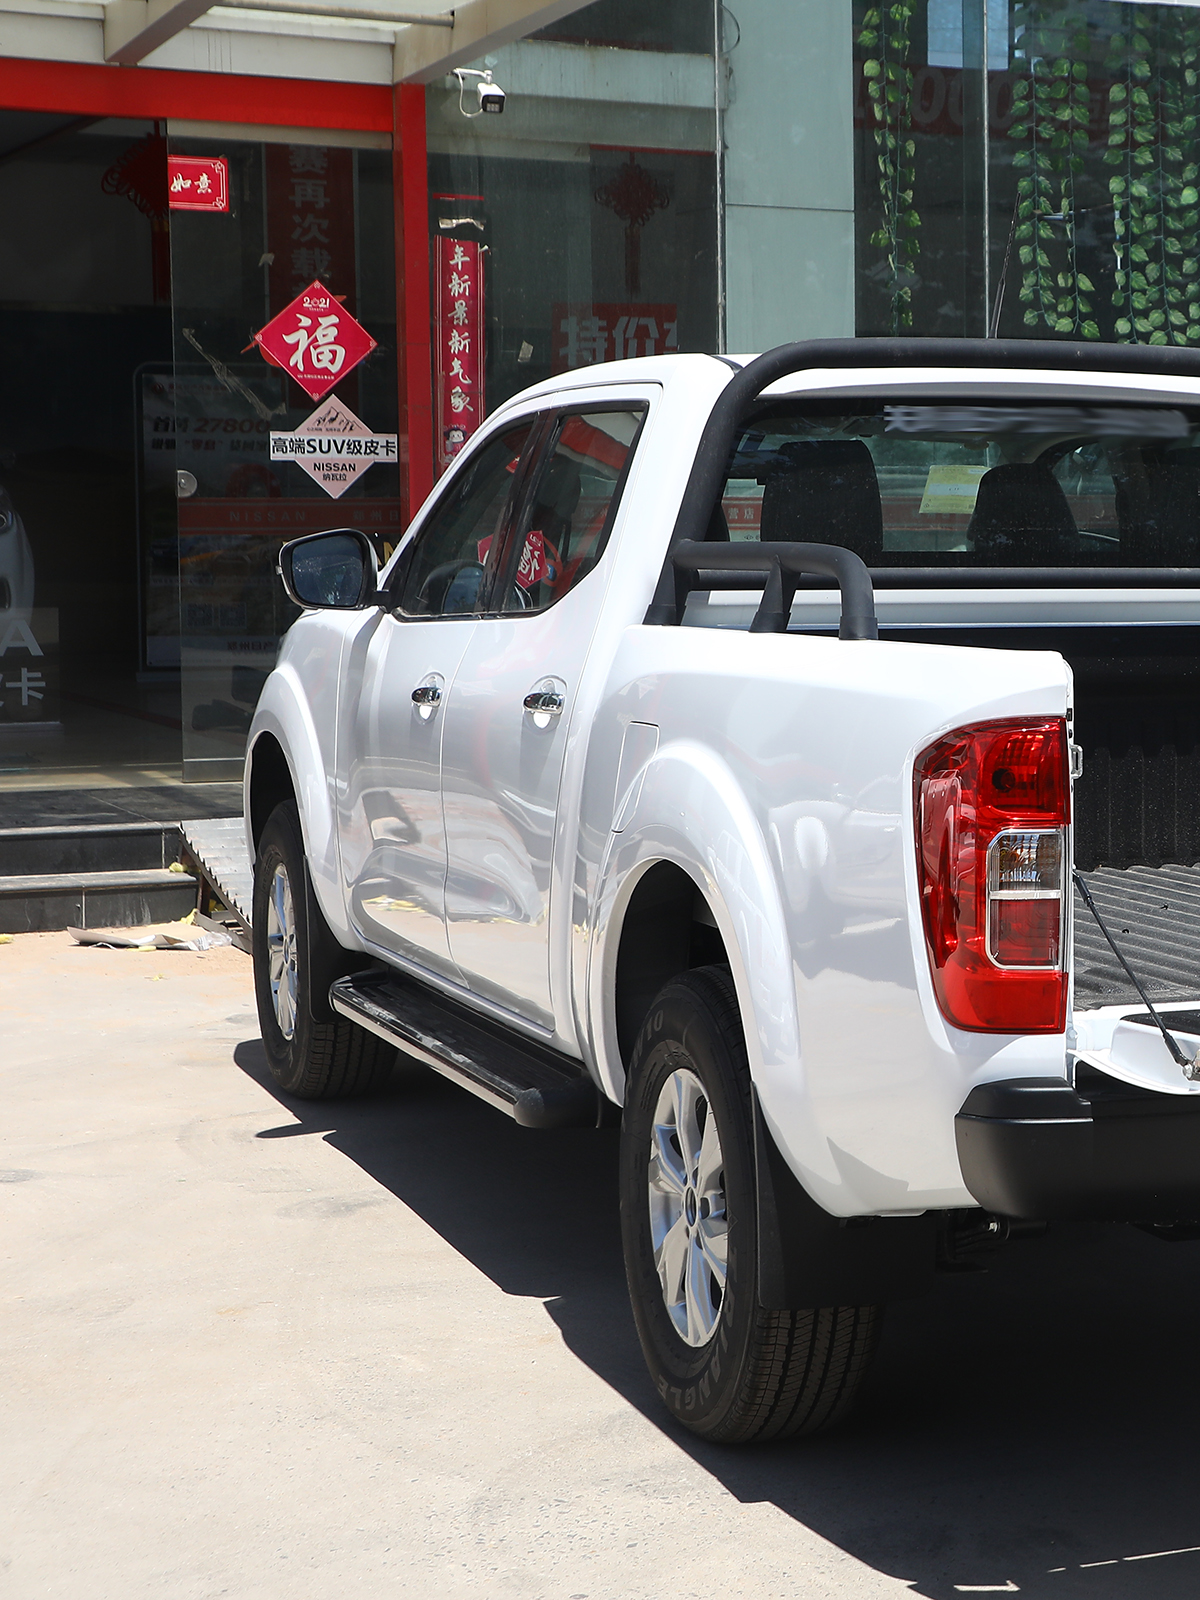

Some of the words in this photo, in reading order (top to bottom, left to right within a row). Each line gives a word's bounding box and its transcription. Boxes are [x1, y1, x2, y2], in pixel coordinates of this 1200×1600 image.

[170, 172, 212, 195] 如意
[288, 144, 332, 297] 赛再次载
[303, 297, 330, 308] 2021
[282, 313, 346, 374] 福
[559, 315, 677, 365] 特价
[193, 417, 271, 433] 27800
[271, 437, 397, 457] 高端SUV级皮卡
[313, 463, 356, 472] NISSAN
[322, 473, 347, 481] 纳瓦拉
[230, 511, 306, 522] NISSAN
[0, 667, 46, 707] 卡
